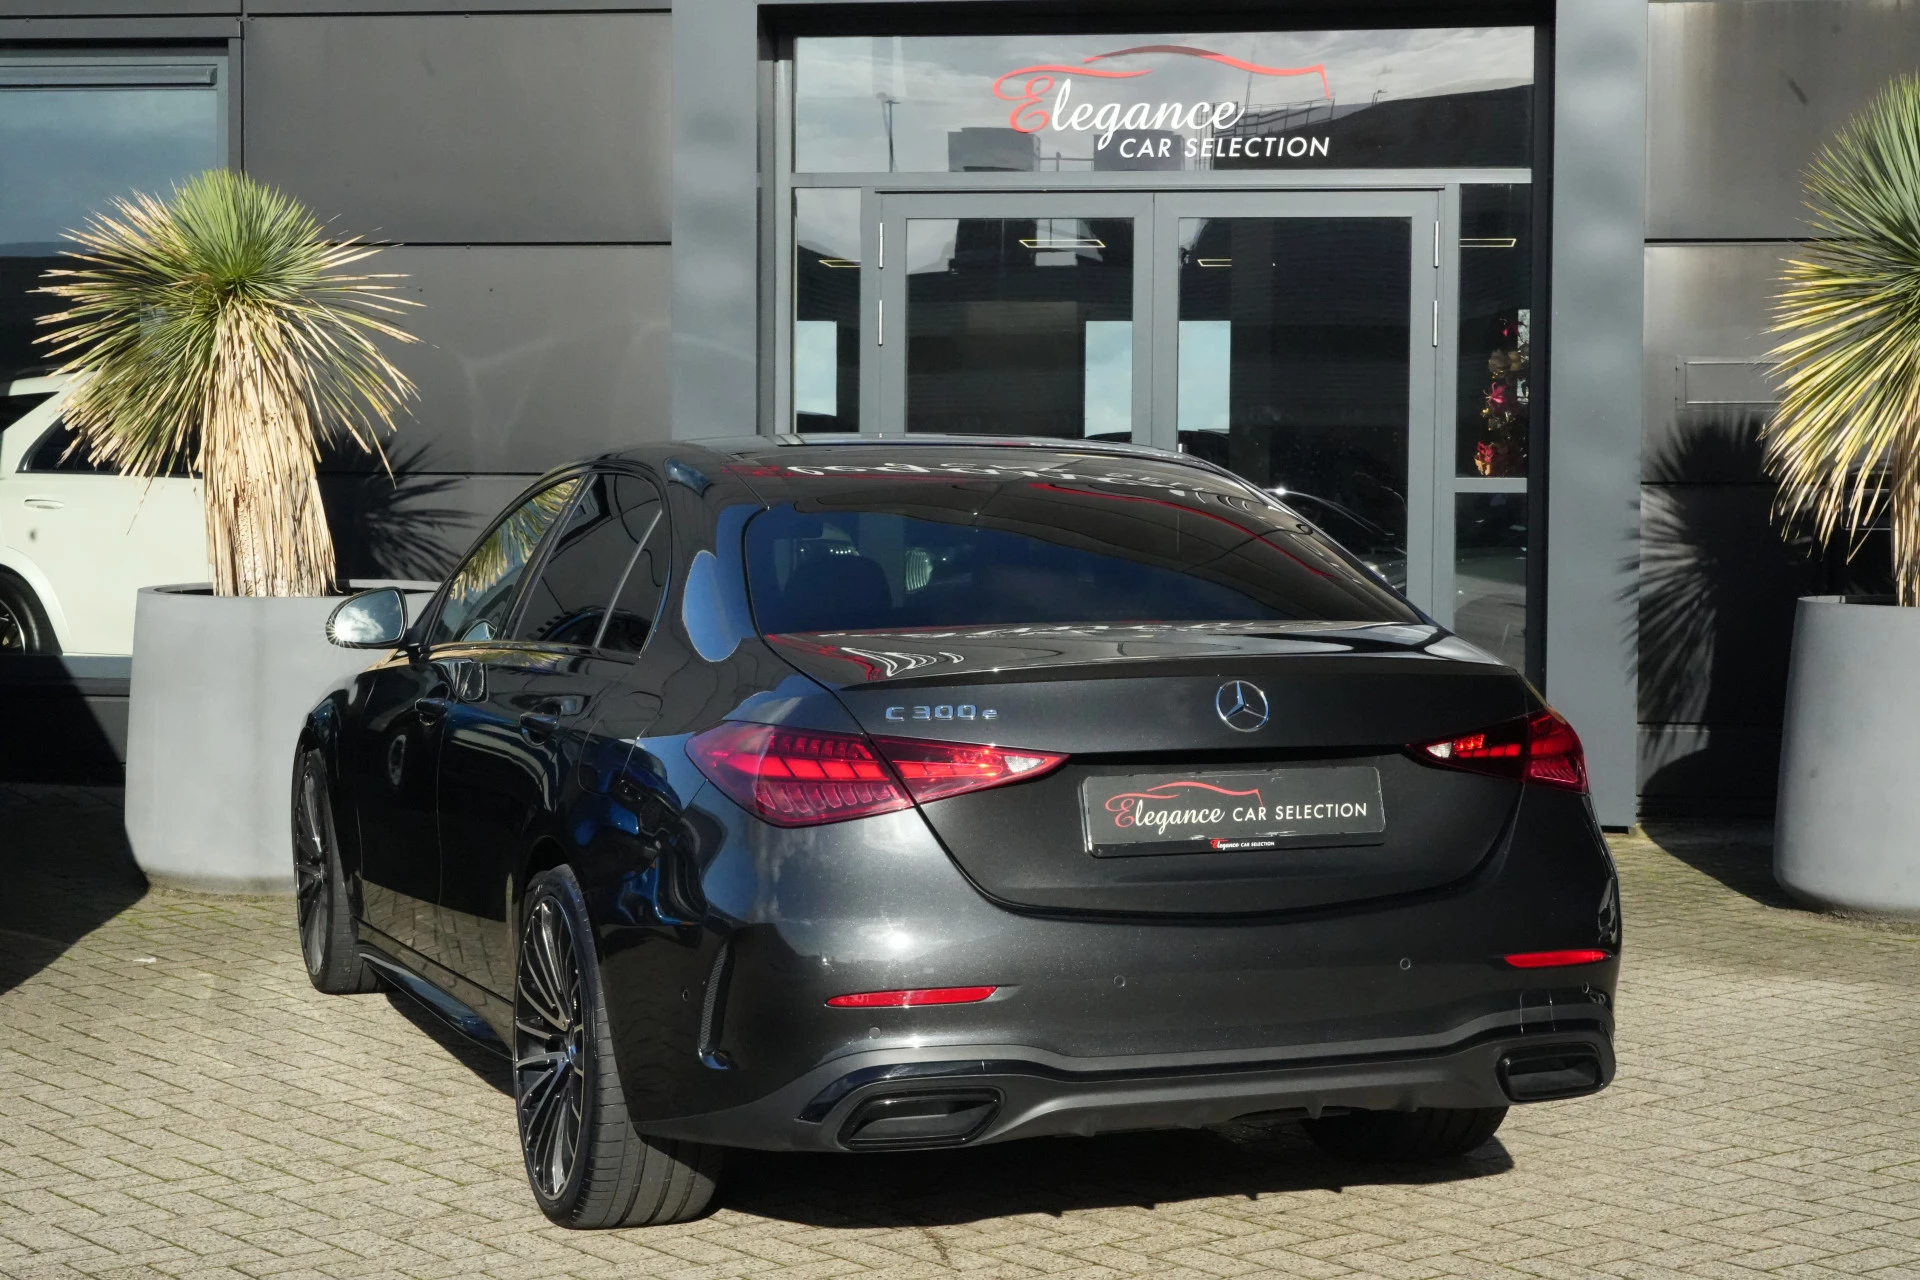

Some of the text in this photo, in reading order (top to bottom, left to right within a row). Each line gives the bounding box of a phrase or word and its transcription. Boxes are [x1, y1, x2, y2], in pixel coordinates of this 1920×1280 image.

[994, 67, 1245, 150] Elegance
[1120, 136, 1330, 158] CAR SELECTION
[885, 706, 905, 722] C
[1105, 793, 1368, 834] Elegance CAR SELECTION
[1210, 838, 1240, 851] Elegance
